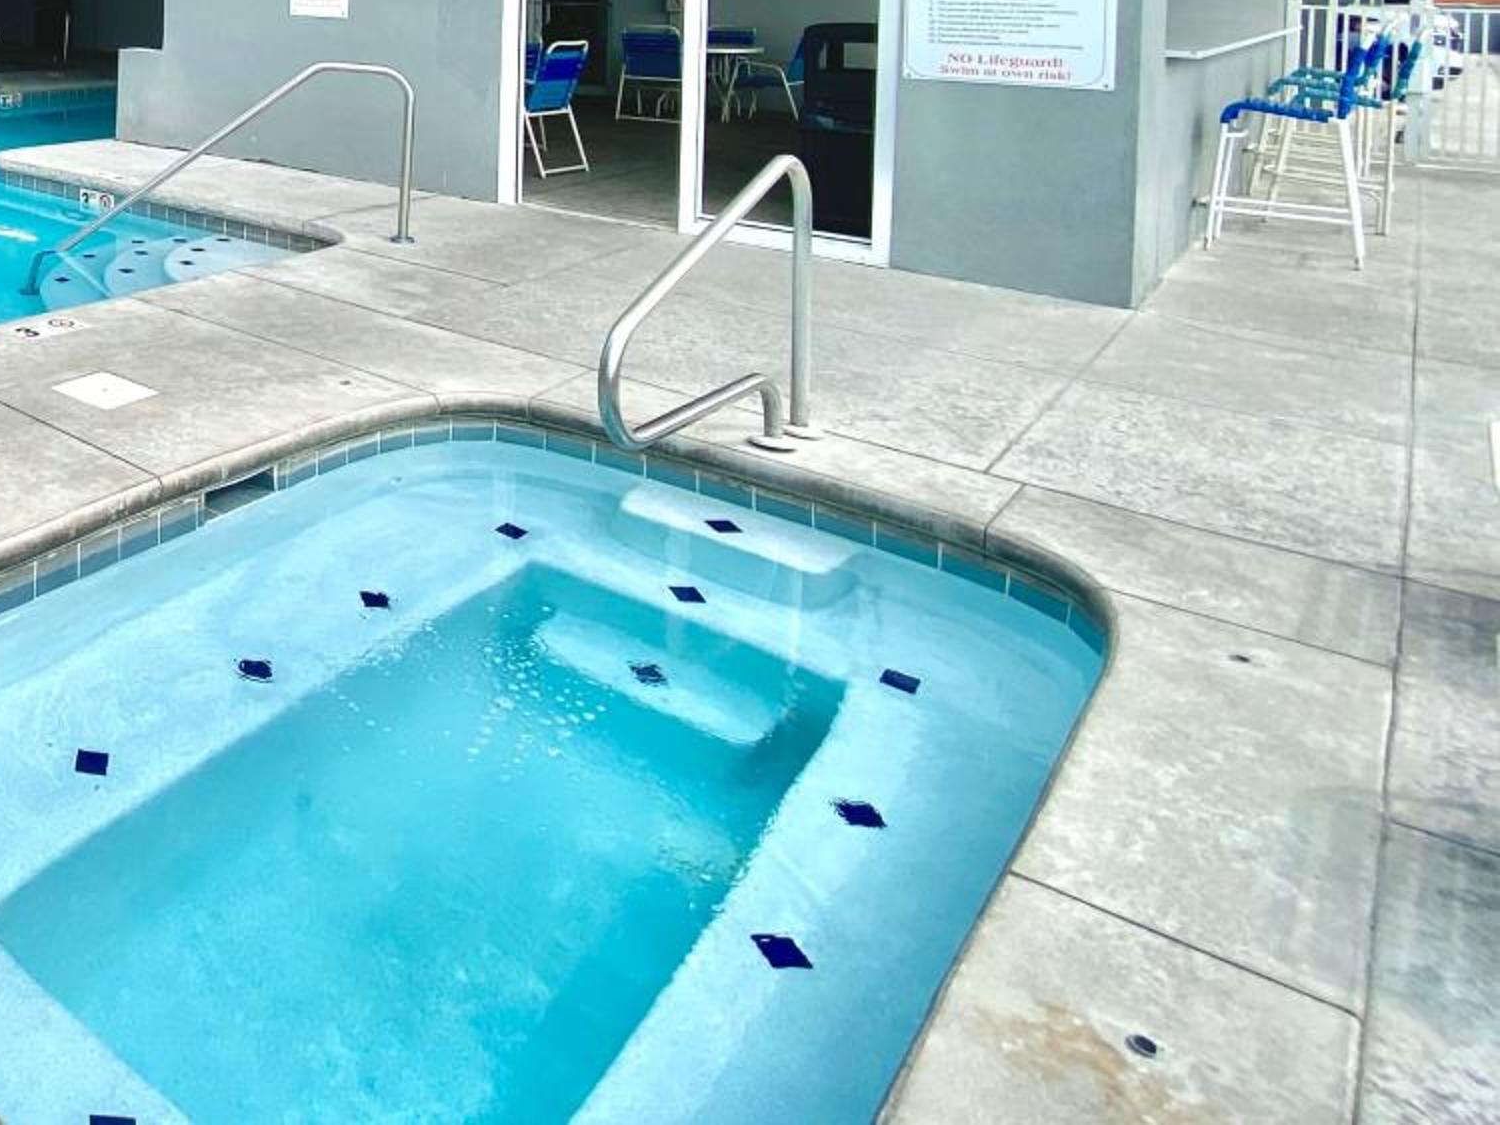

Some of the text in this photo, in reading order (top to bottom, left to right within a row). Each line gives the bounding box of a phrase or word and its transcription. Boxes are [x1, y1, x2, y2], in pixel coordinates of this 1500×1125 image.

[947, 53, 1063, 69] NO Lifeguard!
[940, 64, 979, 76] Swim
[983, 68, 997, 76] at
[1001, 70, 1033, 79] own
